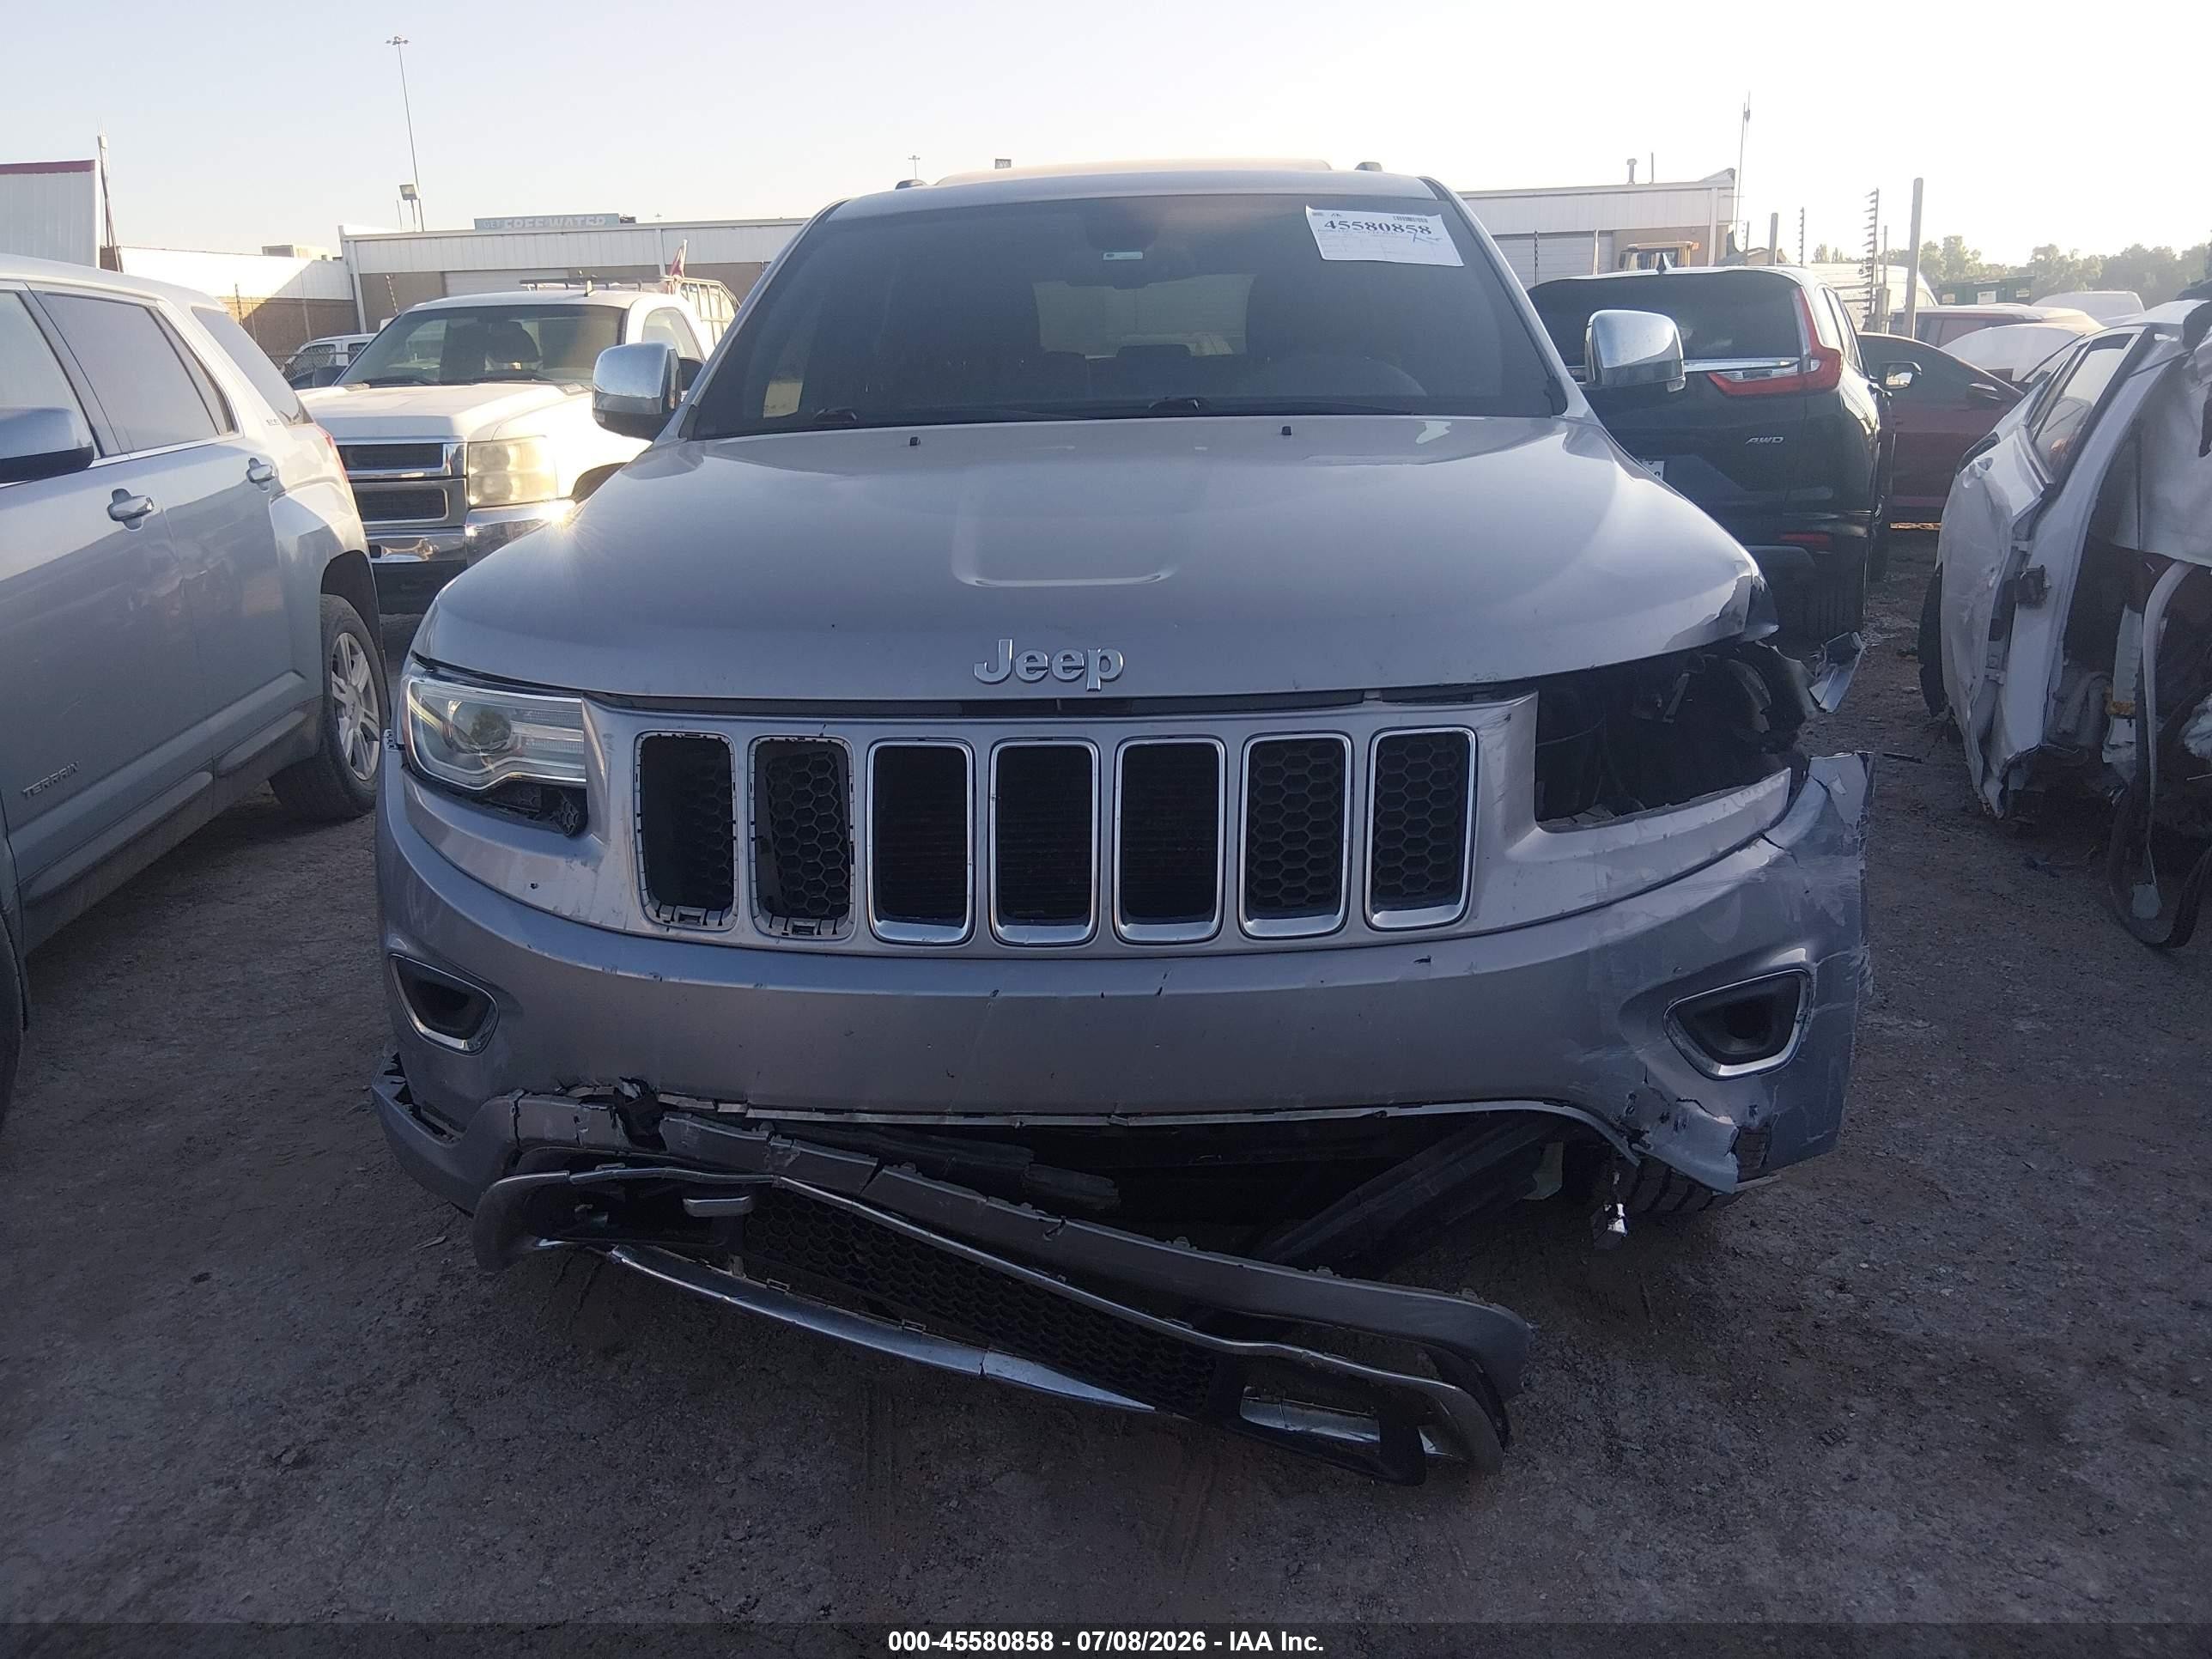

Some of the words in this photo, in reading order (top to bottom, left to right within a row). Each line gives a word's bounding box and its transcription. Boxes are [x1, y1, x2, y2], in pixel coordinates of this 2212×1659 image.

[1324, 220, 1431, 235] 45580858
[1745, 436, 1784, 445] AWD
[974, 638, 1124, 692] Jeep
[22, 761, 80, 798] TERRAIN
